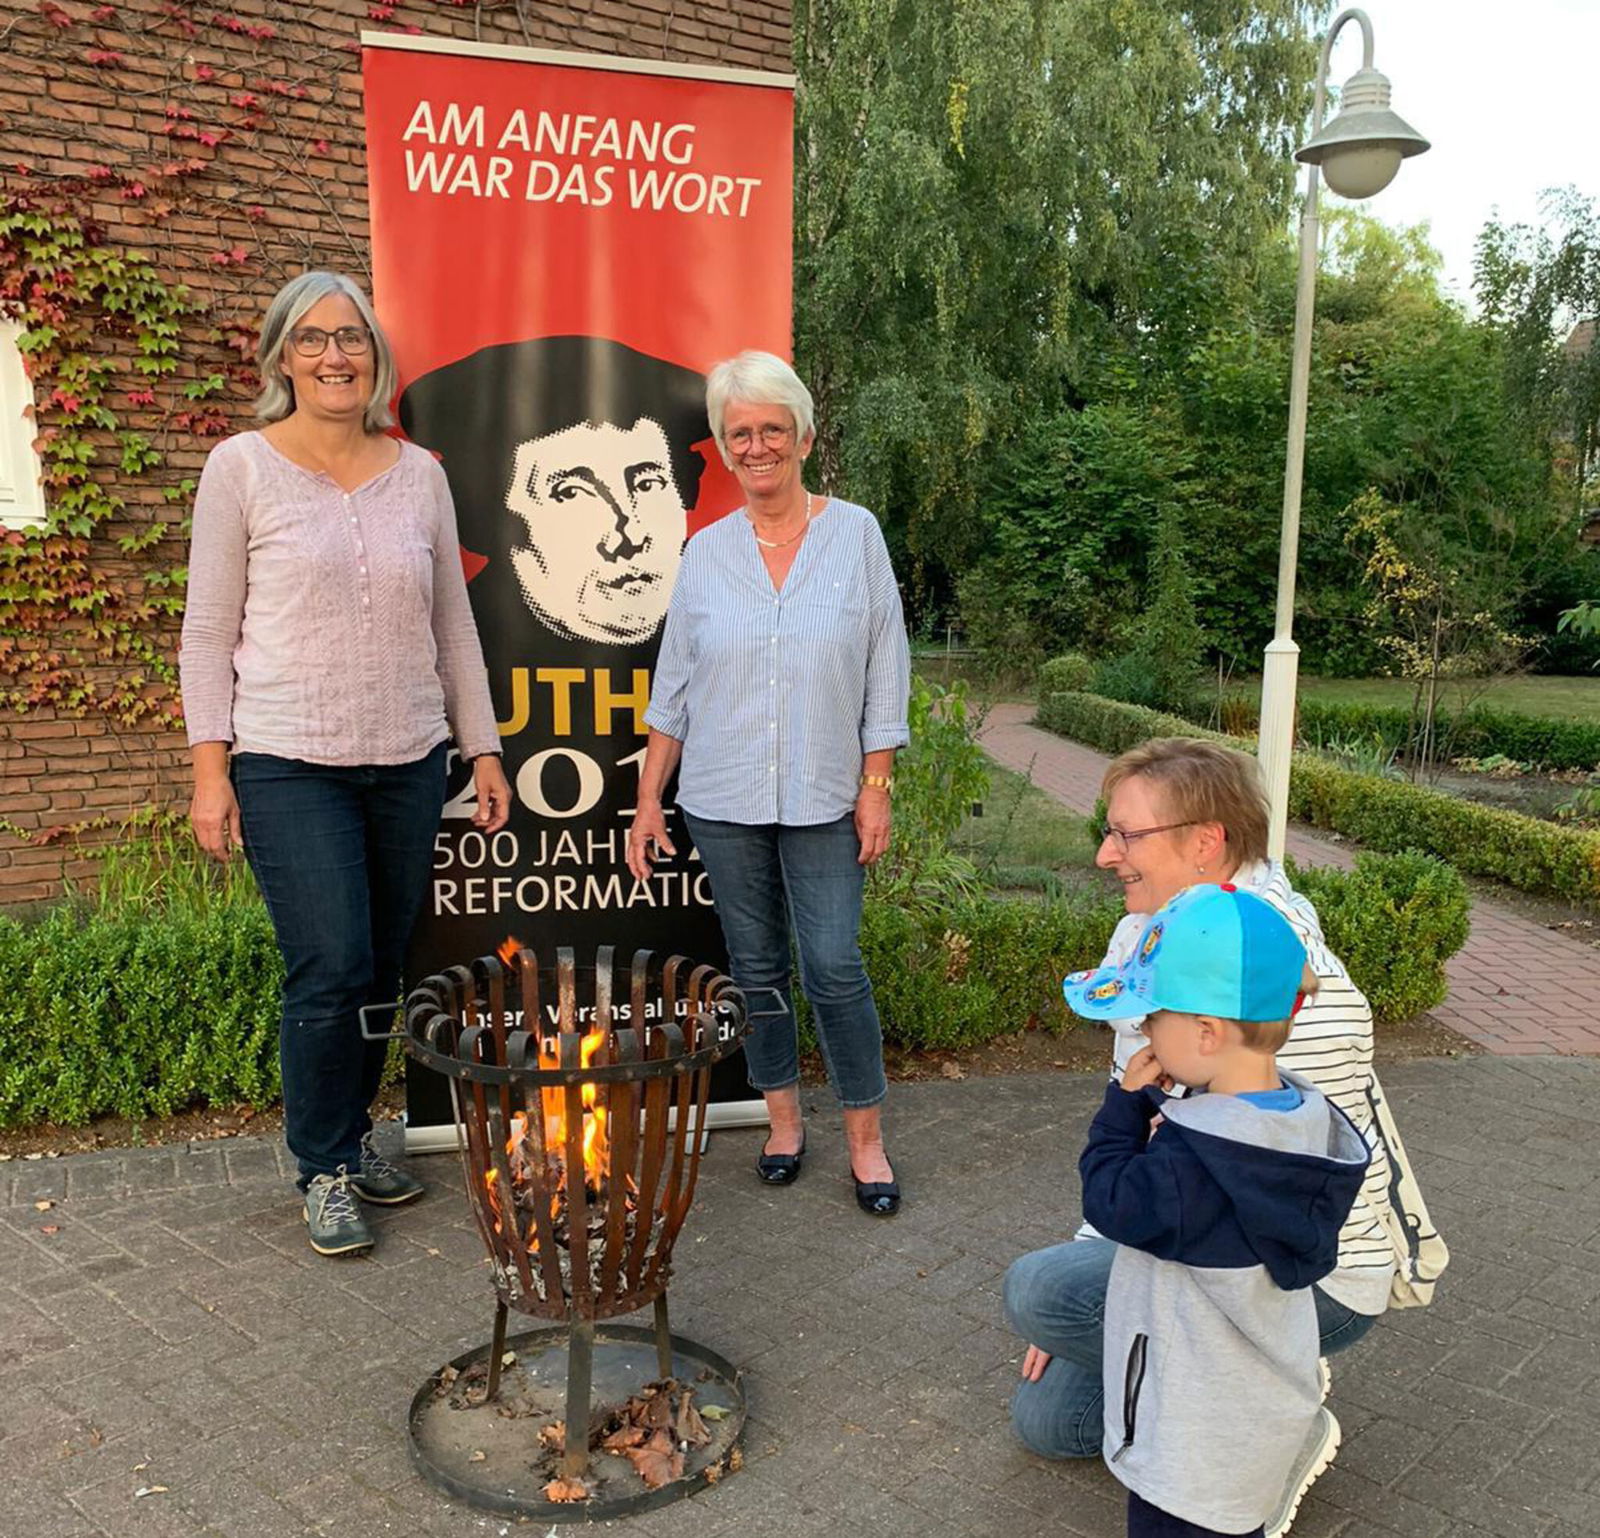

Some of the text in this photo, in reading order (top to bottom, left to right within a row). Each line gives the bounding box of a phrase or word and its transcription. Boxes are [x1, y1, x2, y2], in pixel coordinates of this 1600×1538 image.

[402, 100, 697, 166] AM ANFANG
[404, 149, 762, 218] WAR DAS WORT
[495, 667, 649, 737] UTH
[441, 747, 675, 819] 201
[433, 830, 519, 870] 500
[433, 872, 715, 916] REFORMATIO
